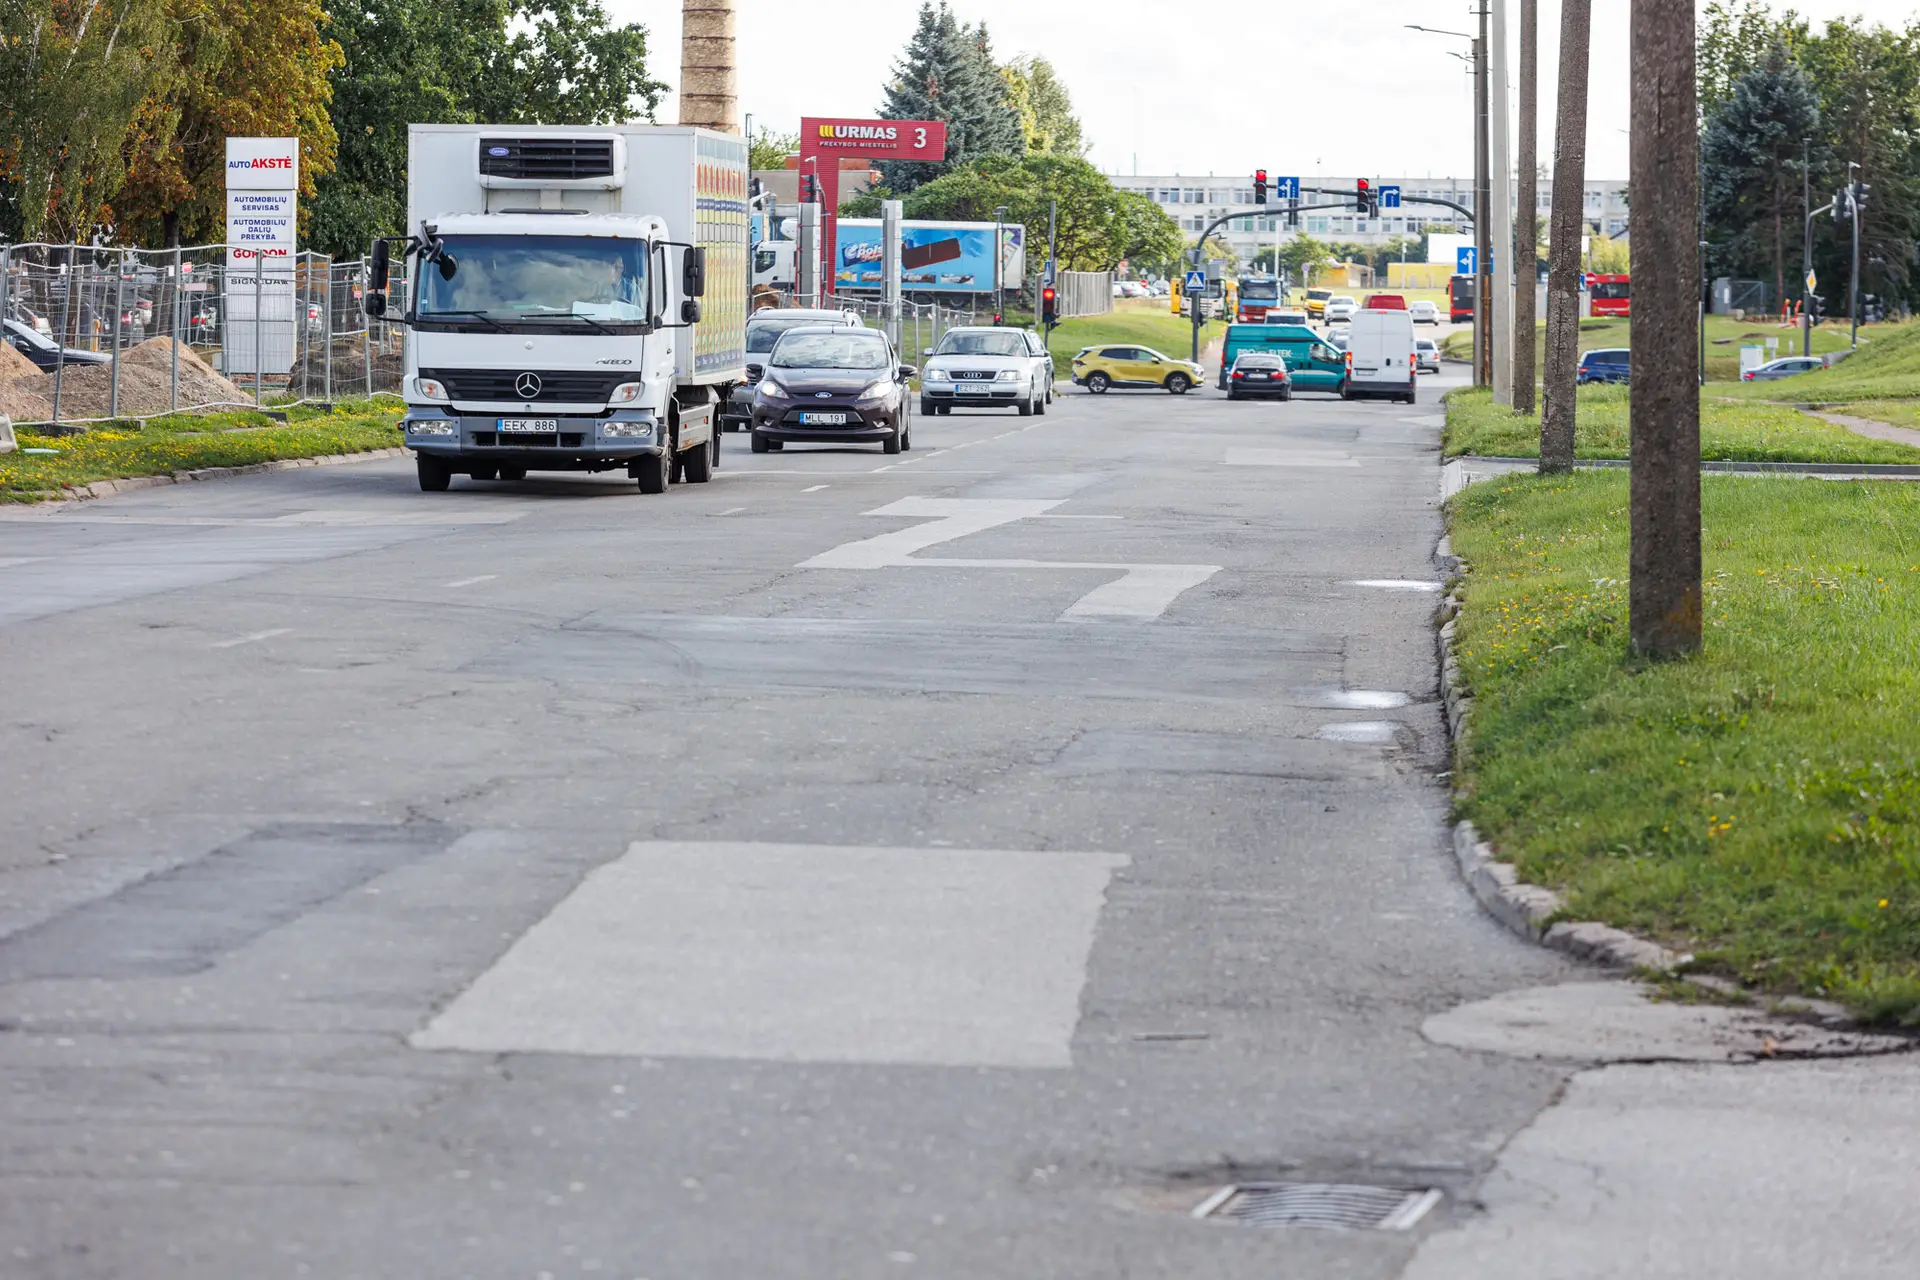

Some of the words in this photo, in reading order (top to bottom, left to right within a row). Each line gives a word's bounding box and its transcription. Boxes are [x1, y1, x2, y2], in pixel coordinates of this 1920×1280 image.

[835, 125, 898, 140] URMAS
[913, 127, 927, 149] 3
[859, 141, 898, 149] MIESTELIS
[233, 196, 287, 204] AUTOMOBILIŲ
[804, 414, 821, 422] MLL
[829, 414, 845, 422] 191
[504, 420, 528, 431] EEK
[534, 420, 555, 431] 886
